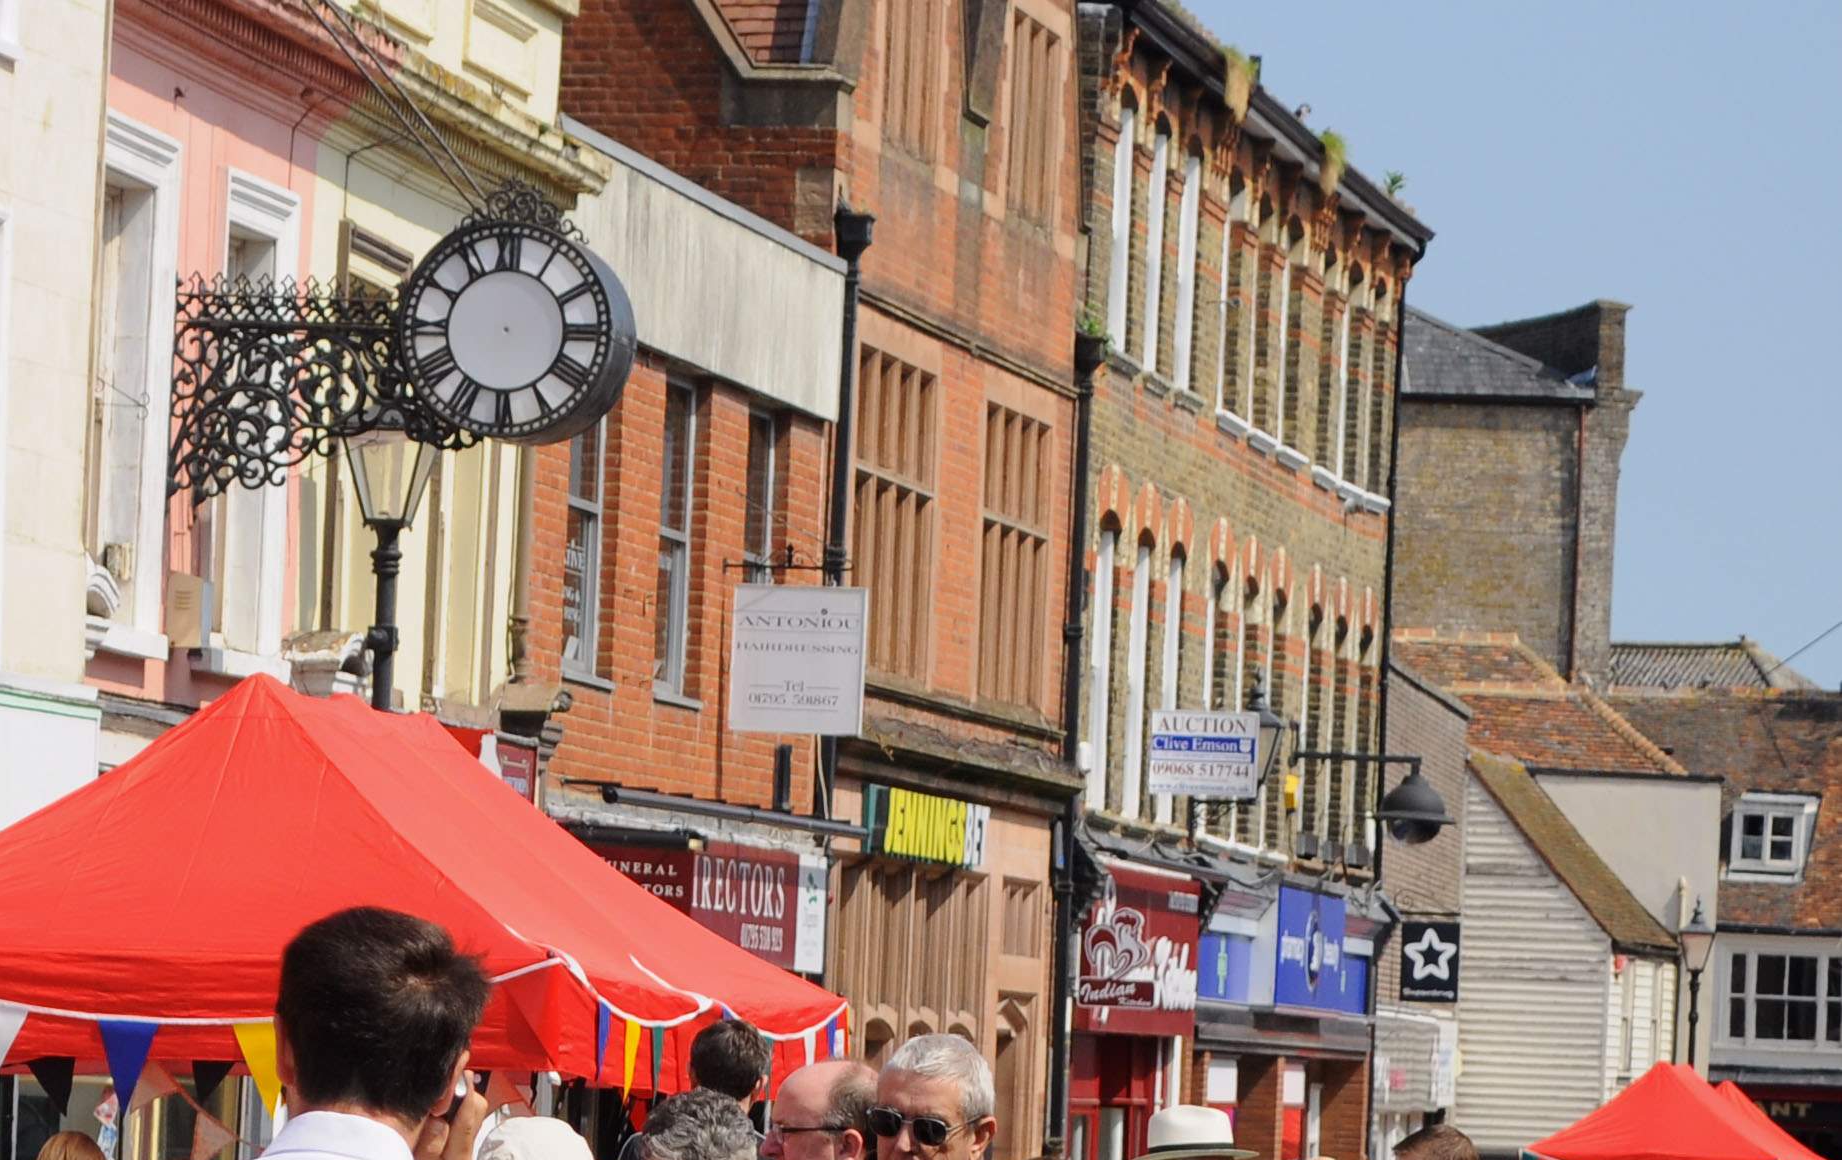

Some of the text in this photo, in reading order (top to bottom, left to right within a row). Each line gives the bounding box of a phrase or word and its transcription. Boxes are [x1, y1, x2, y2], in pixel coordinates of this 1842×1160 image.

[736, 640, 859, 656] HAIRDRESSING
[784, 680, 804, 692] Tel
[1158, 716, 1247, 734] AUCTION
[1153, 736, 1238, 752] Clive Emson
[691, 855, 786, 919] IRECTORS
[1080, 981, 1137, 1003] Indian
